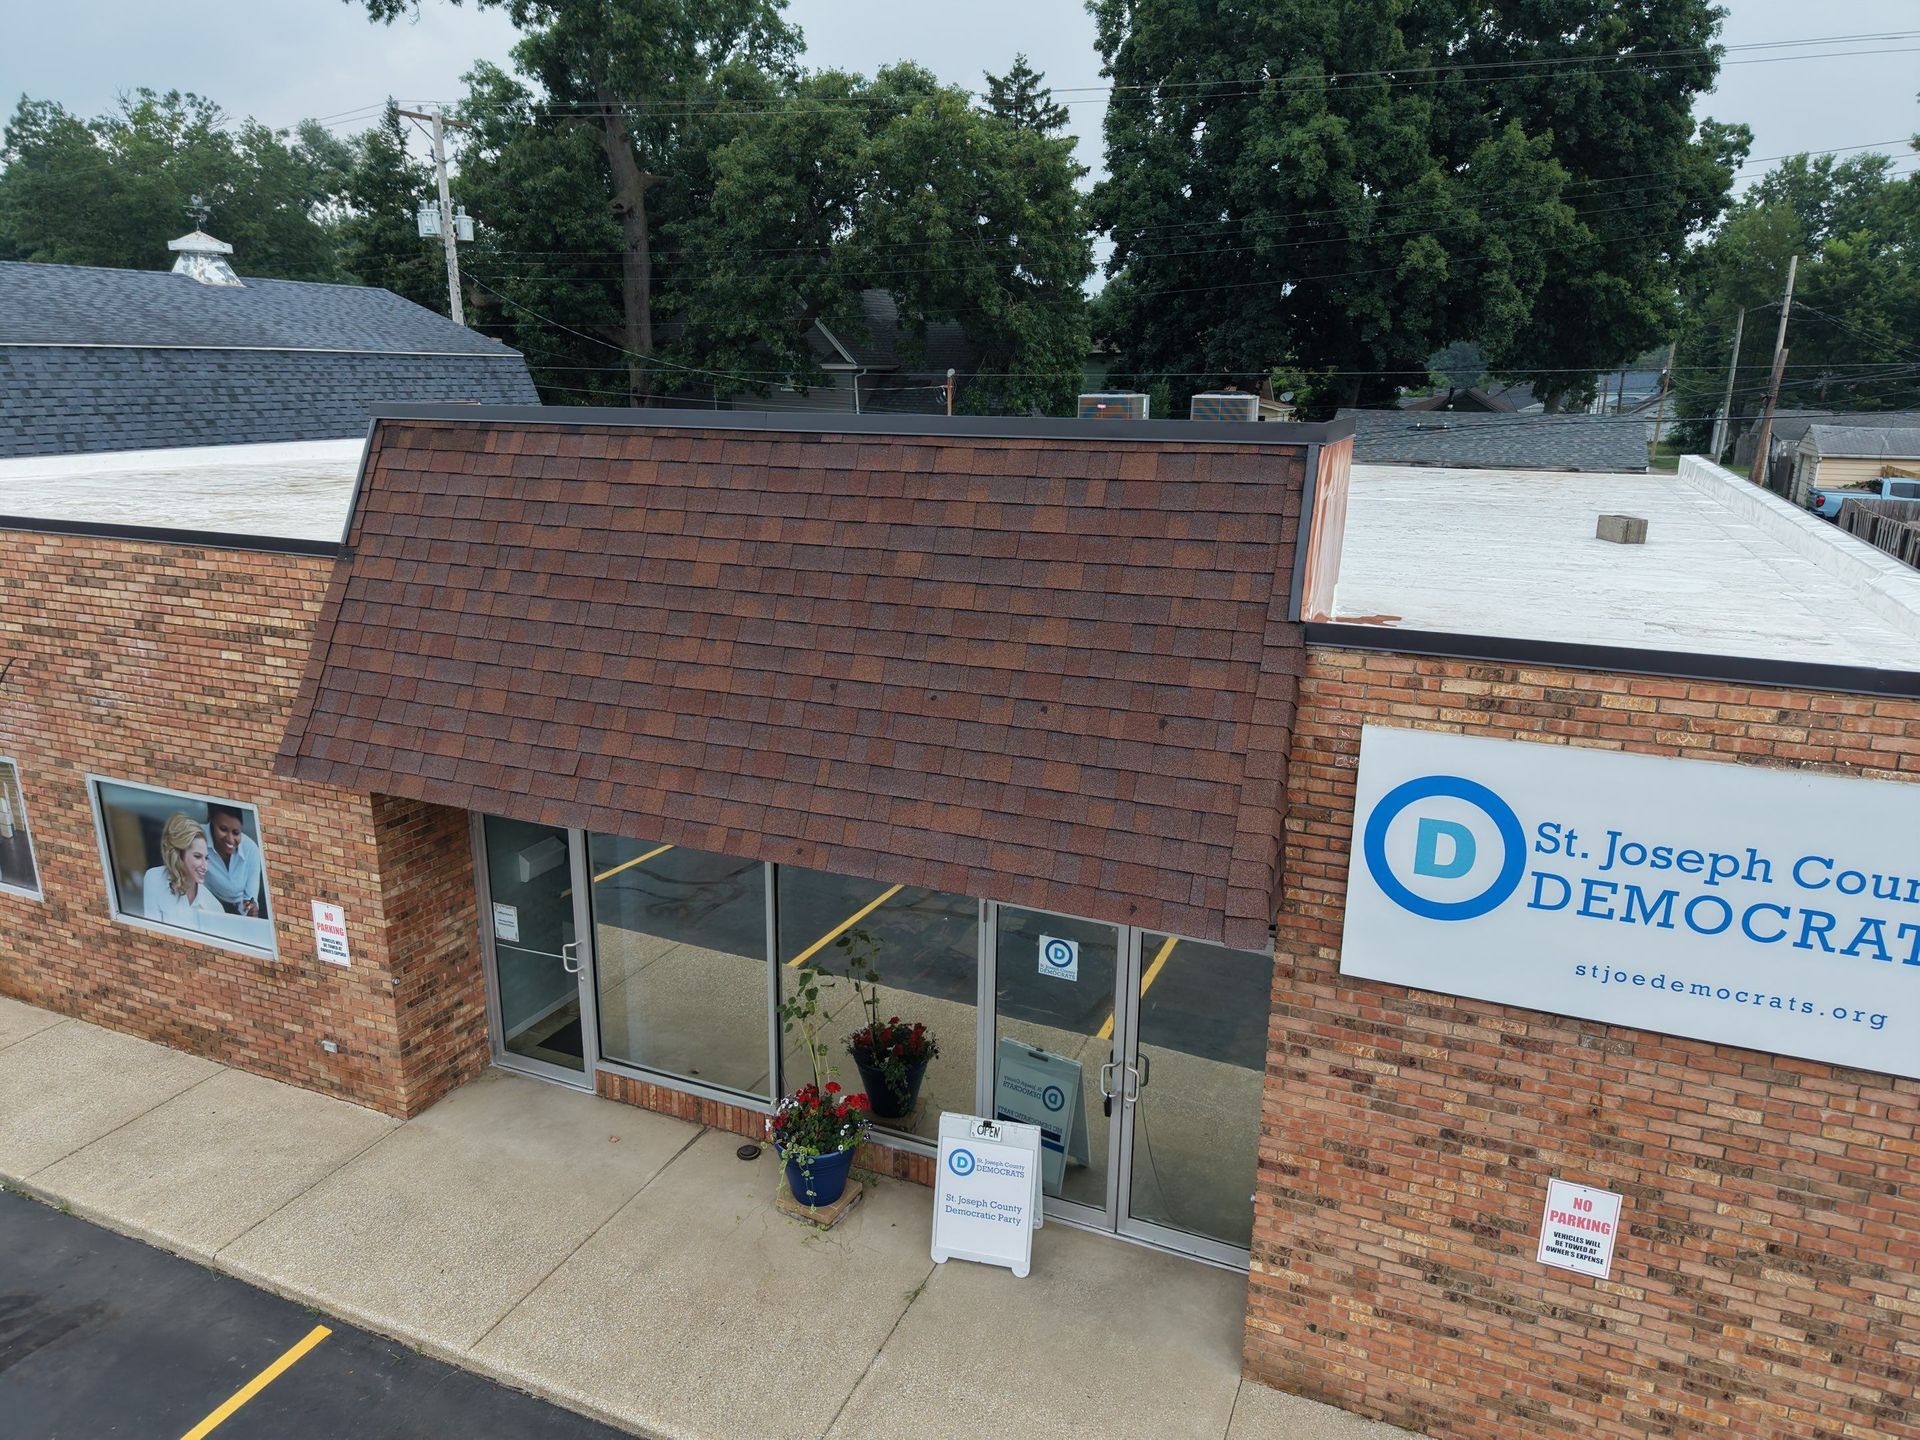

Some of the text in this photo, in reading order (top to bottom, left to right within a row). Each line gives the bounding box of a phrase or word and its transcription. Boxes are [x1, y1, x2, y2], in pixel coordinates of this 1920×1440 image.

[1413, 817, 1477, 879] D
[1535, 822, 1589, 860] St.
[1598, 830, 1773, 886] Joseph
[324, 912, 334, 922] NO
[316, 922, 345, 936] PARKING
[1054, 947, 1066, 960] D
[1575, 963, 1888, 1030] stjoedemocrats.org
[977, 1124, 1001, 1139] OPEN
[957, 1156, 969, 1169] D
[984, 1158, 1003, 1168] Joseph
[1004, 1162, 1025, 1171] County
[976, 1164, 1025, 1178] DEMOCRATS
[945, 1193, 1023, 1214] St. Joseph County
[1573, 1197, 1593, 1213] NO
[945, 1204, 1022, 1227] Democratic Party
[1549, 1210, 1611, 1236] PARKING
[1553, 1231, 1601, 1249] VEHICLES WILL
[1555, 1239, 1564, 1247] BE
[1565, 1242, 1588, 1253] TOWED
[1545, 1245, 1604, 1265] OWNER'S EXPENSE
